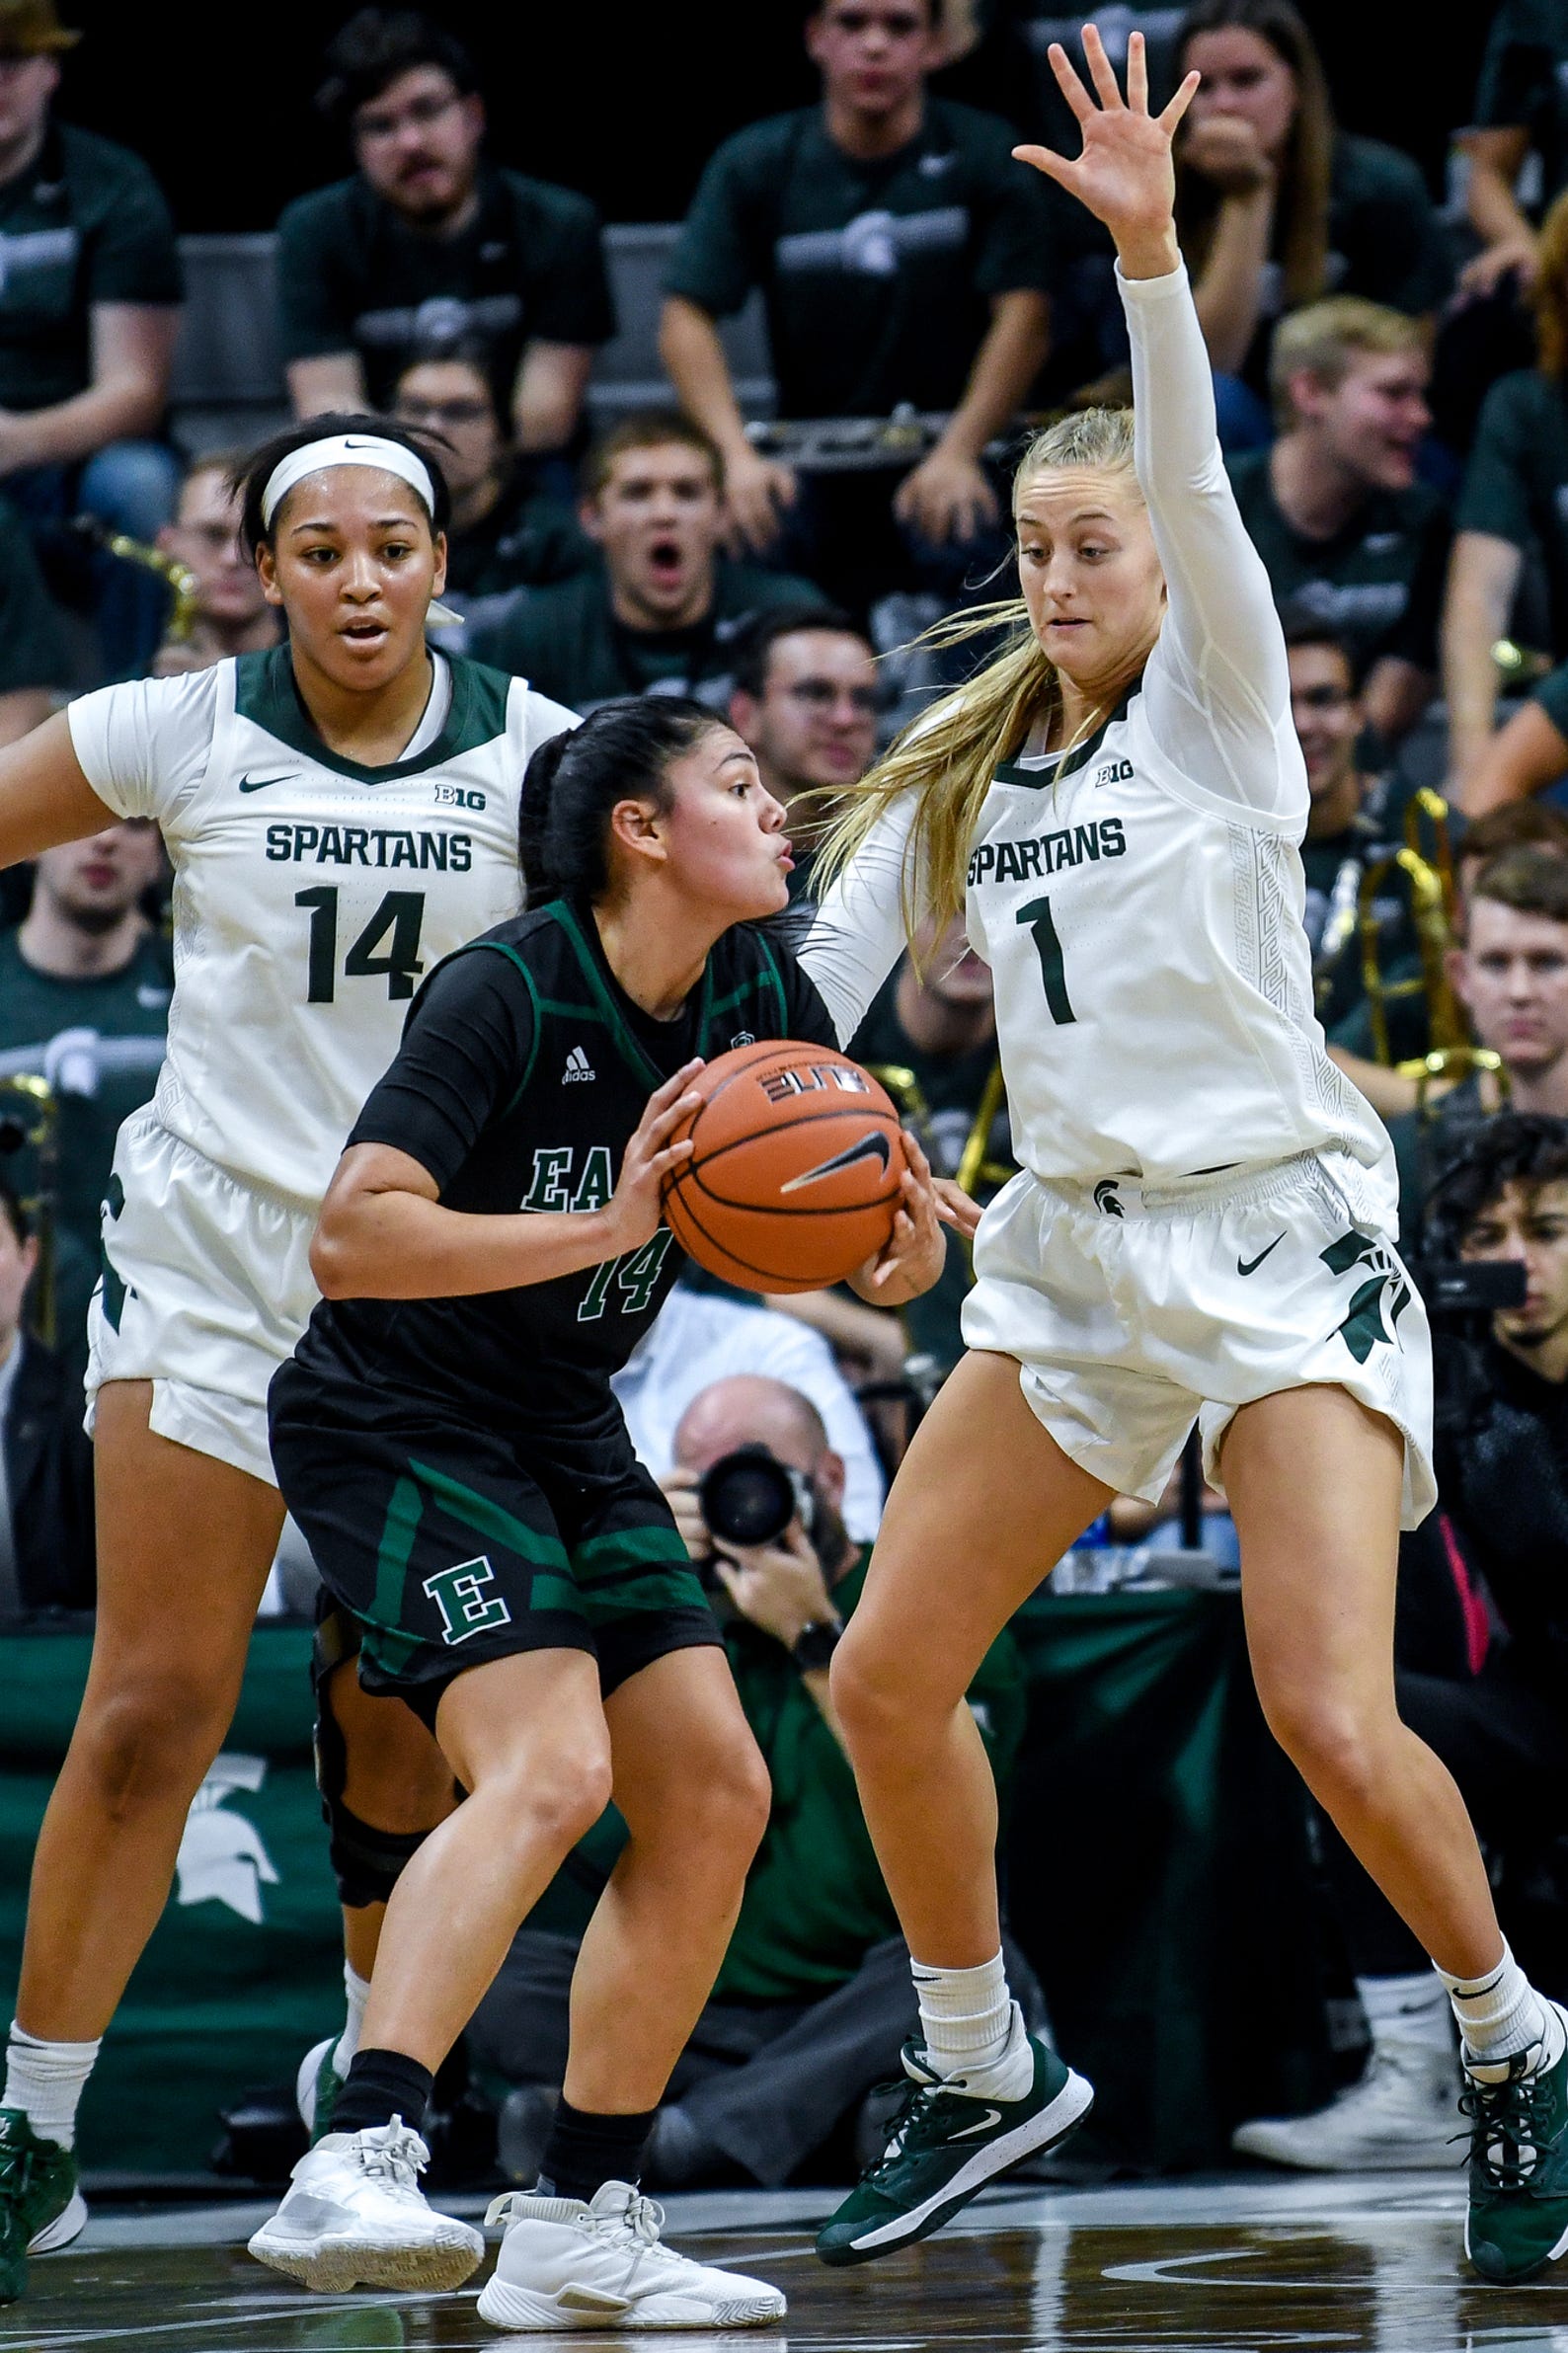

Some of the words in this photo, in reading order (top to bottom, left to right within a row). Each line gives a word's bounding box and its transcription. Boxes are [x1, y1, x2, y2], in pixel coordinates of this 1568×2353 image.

[266, 824, 472, 872] SPARTANS
[967, 818, 1127, 887] SPARTANS
[295, 886, 426, 1002] 14
[1016, 896, 1077, 1025] 1
[561, 1069, 596, 1086] didas
[578, 1227, 674, 1321] 14
[422, 1555, 511, 1645] E
